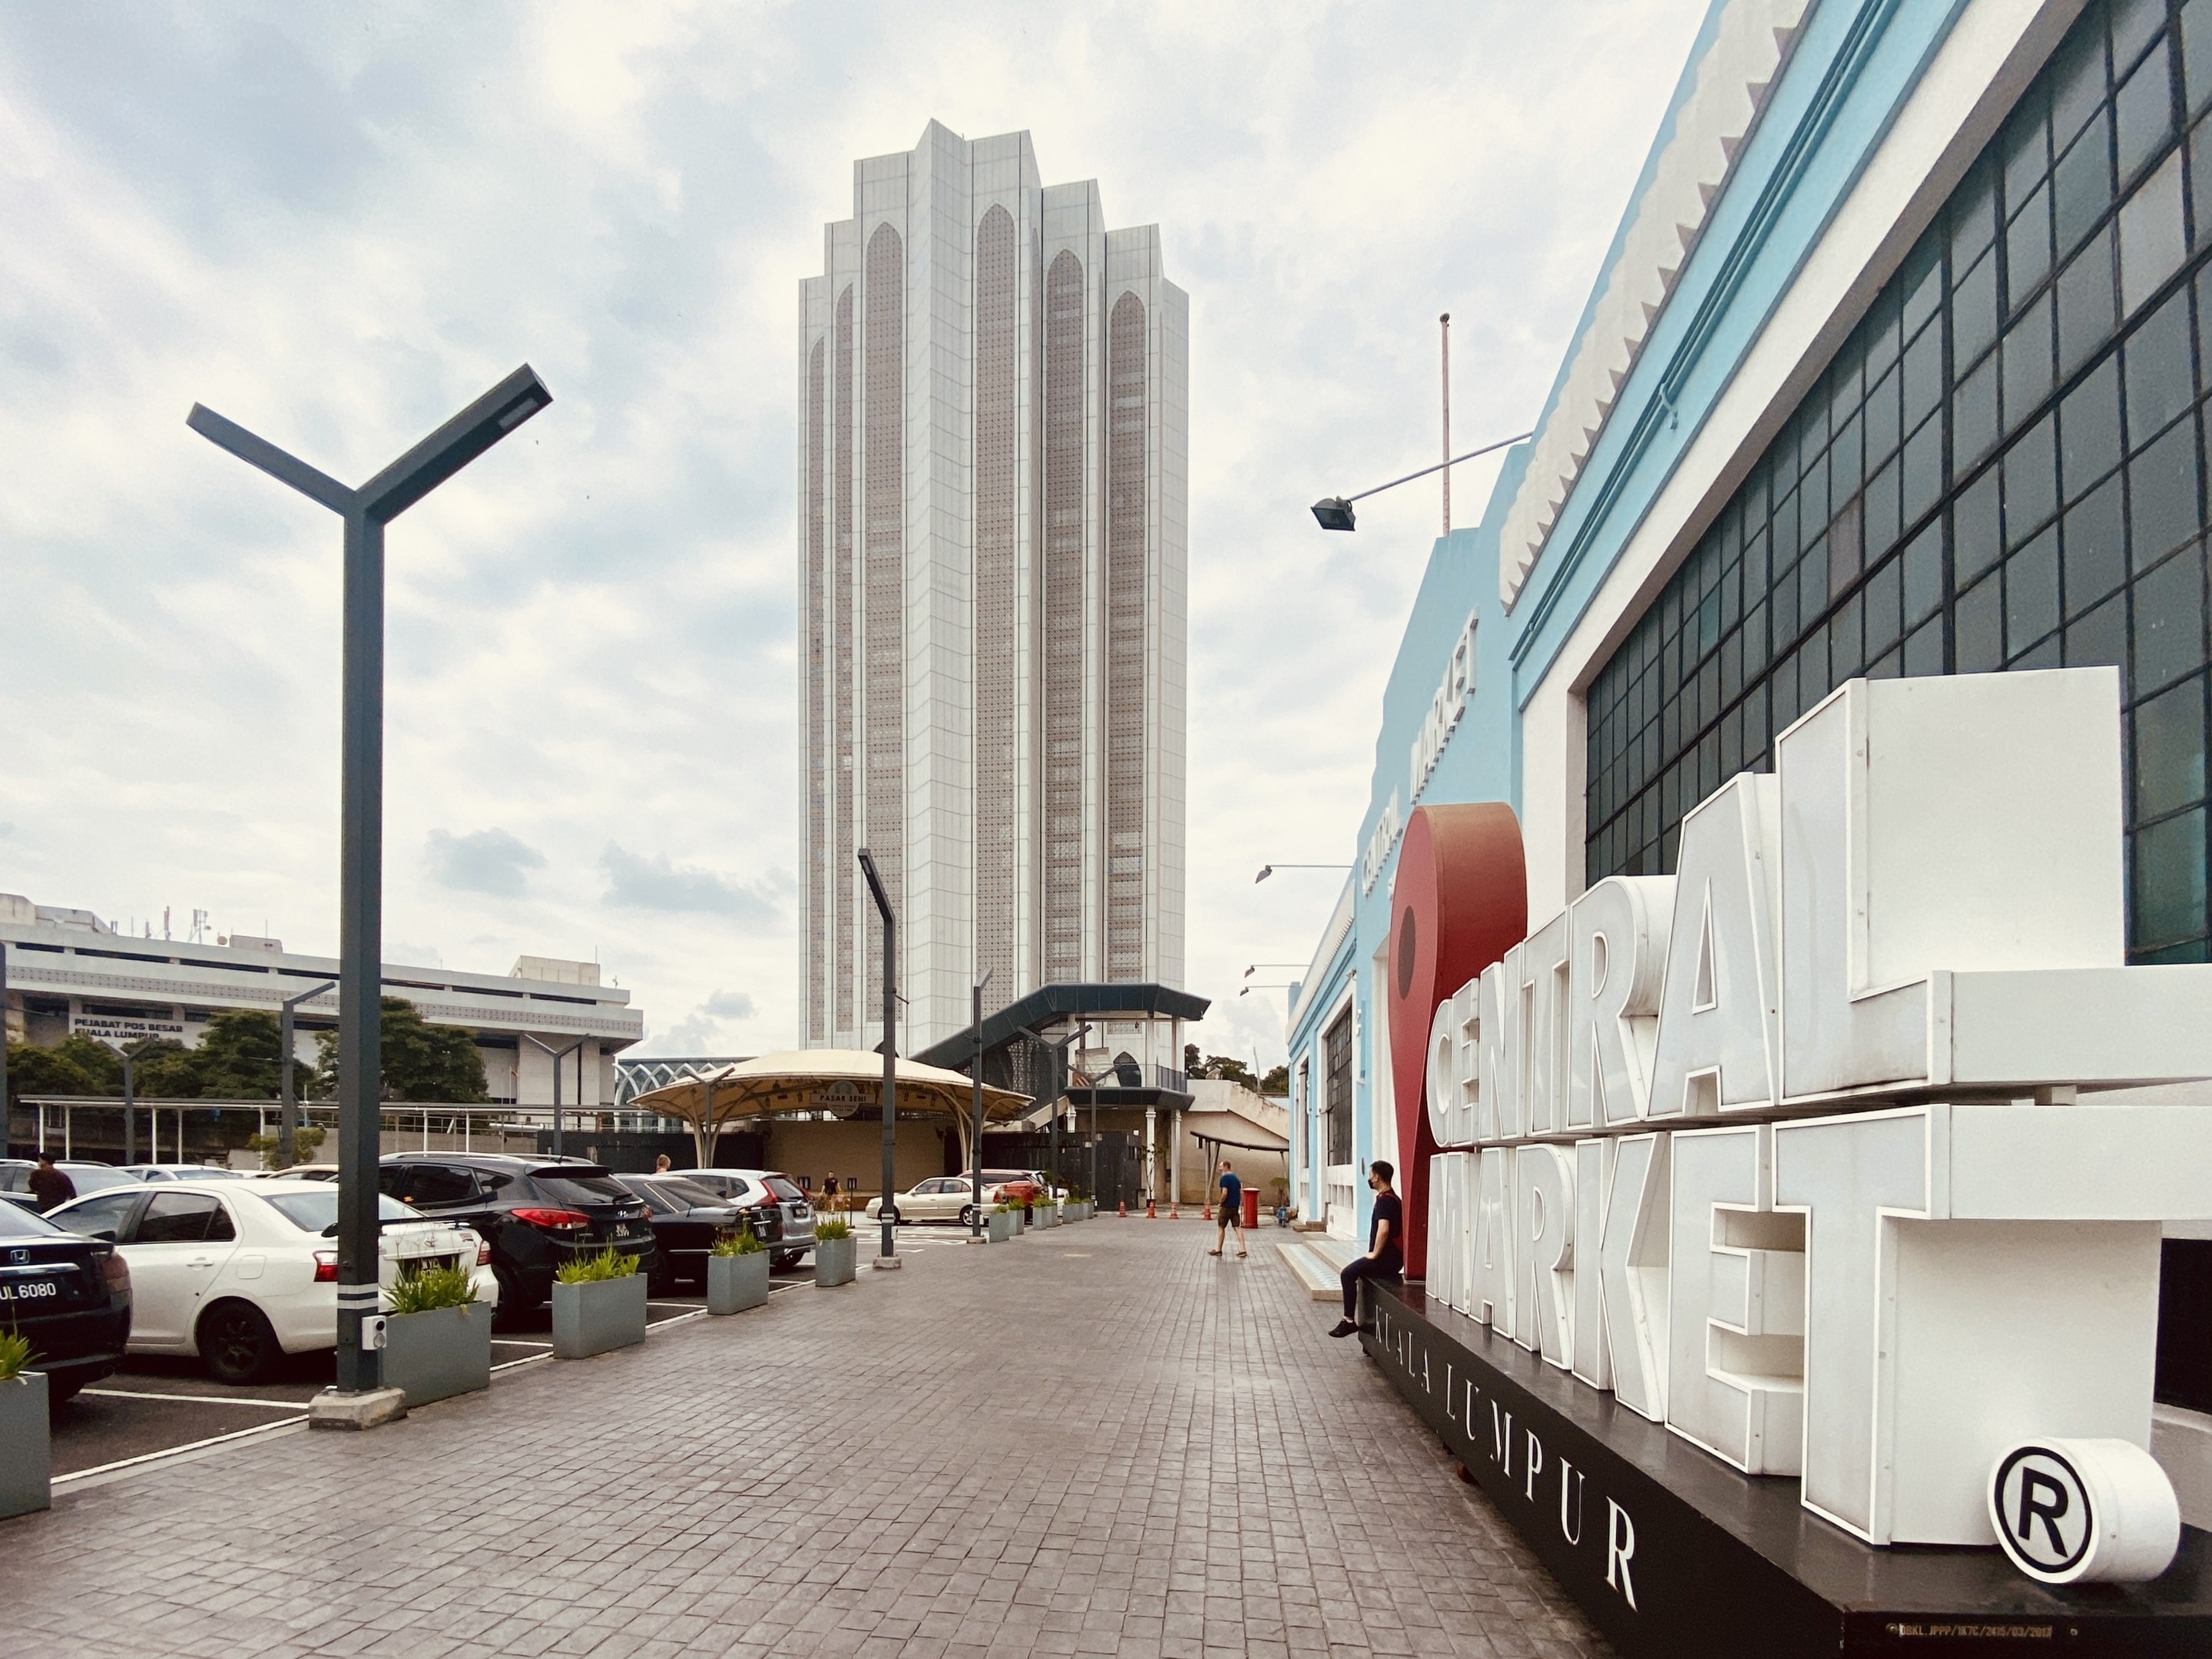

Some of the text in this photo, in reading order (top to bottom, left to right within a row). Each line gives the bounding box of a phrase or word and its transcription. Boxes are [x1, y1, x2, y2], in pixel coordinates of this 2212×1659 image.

[75, 1018, 183, 1033] PEJABAT POS BESAR
[1426, 676, 1951, 1149] CENTRAL
[18, 1283, 56, 1299] 6080
[1425, 1104, 1951, 1547] MARKET
[1376, 1305, 1638, 1613] KUALA LUMPUR
